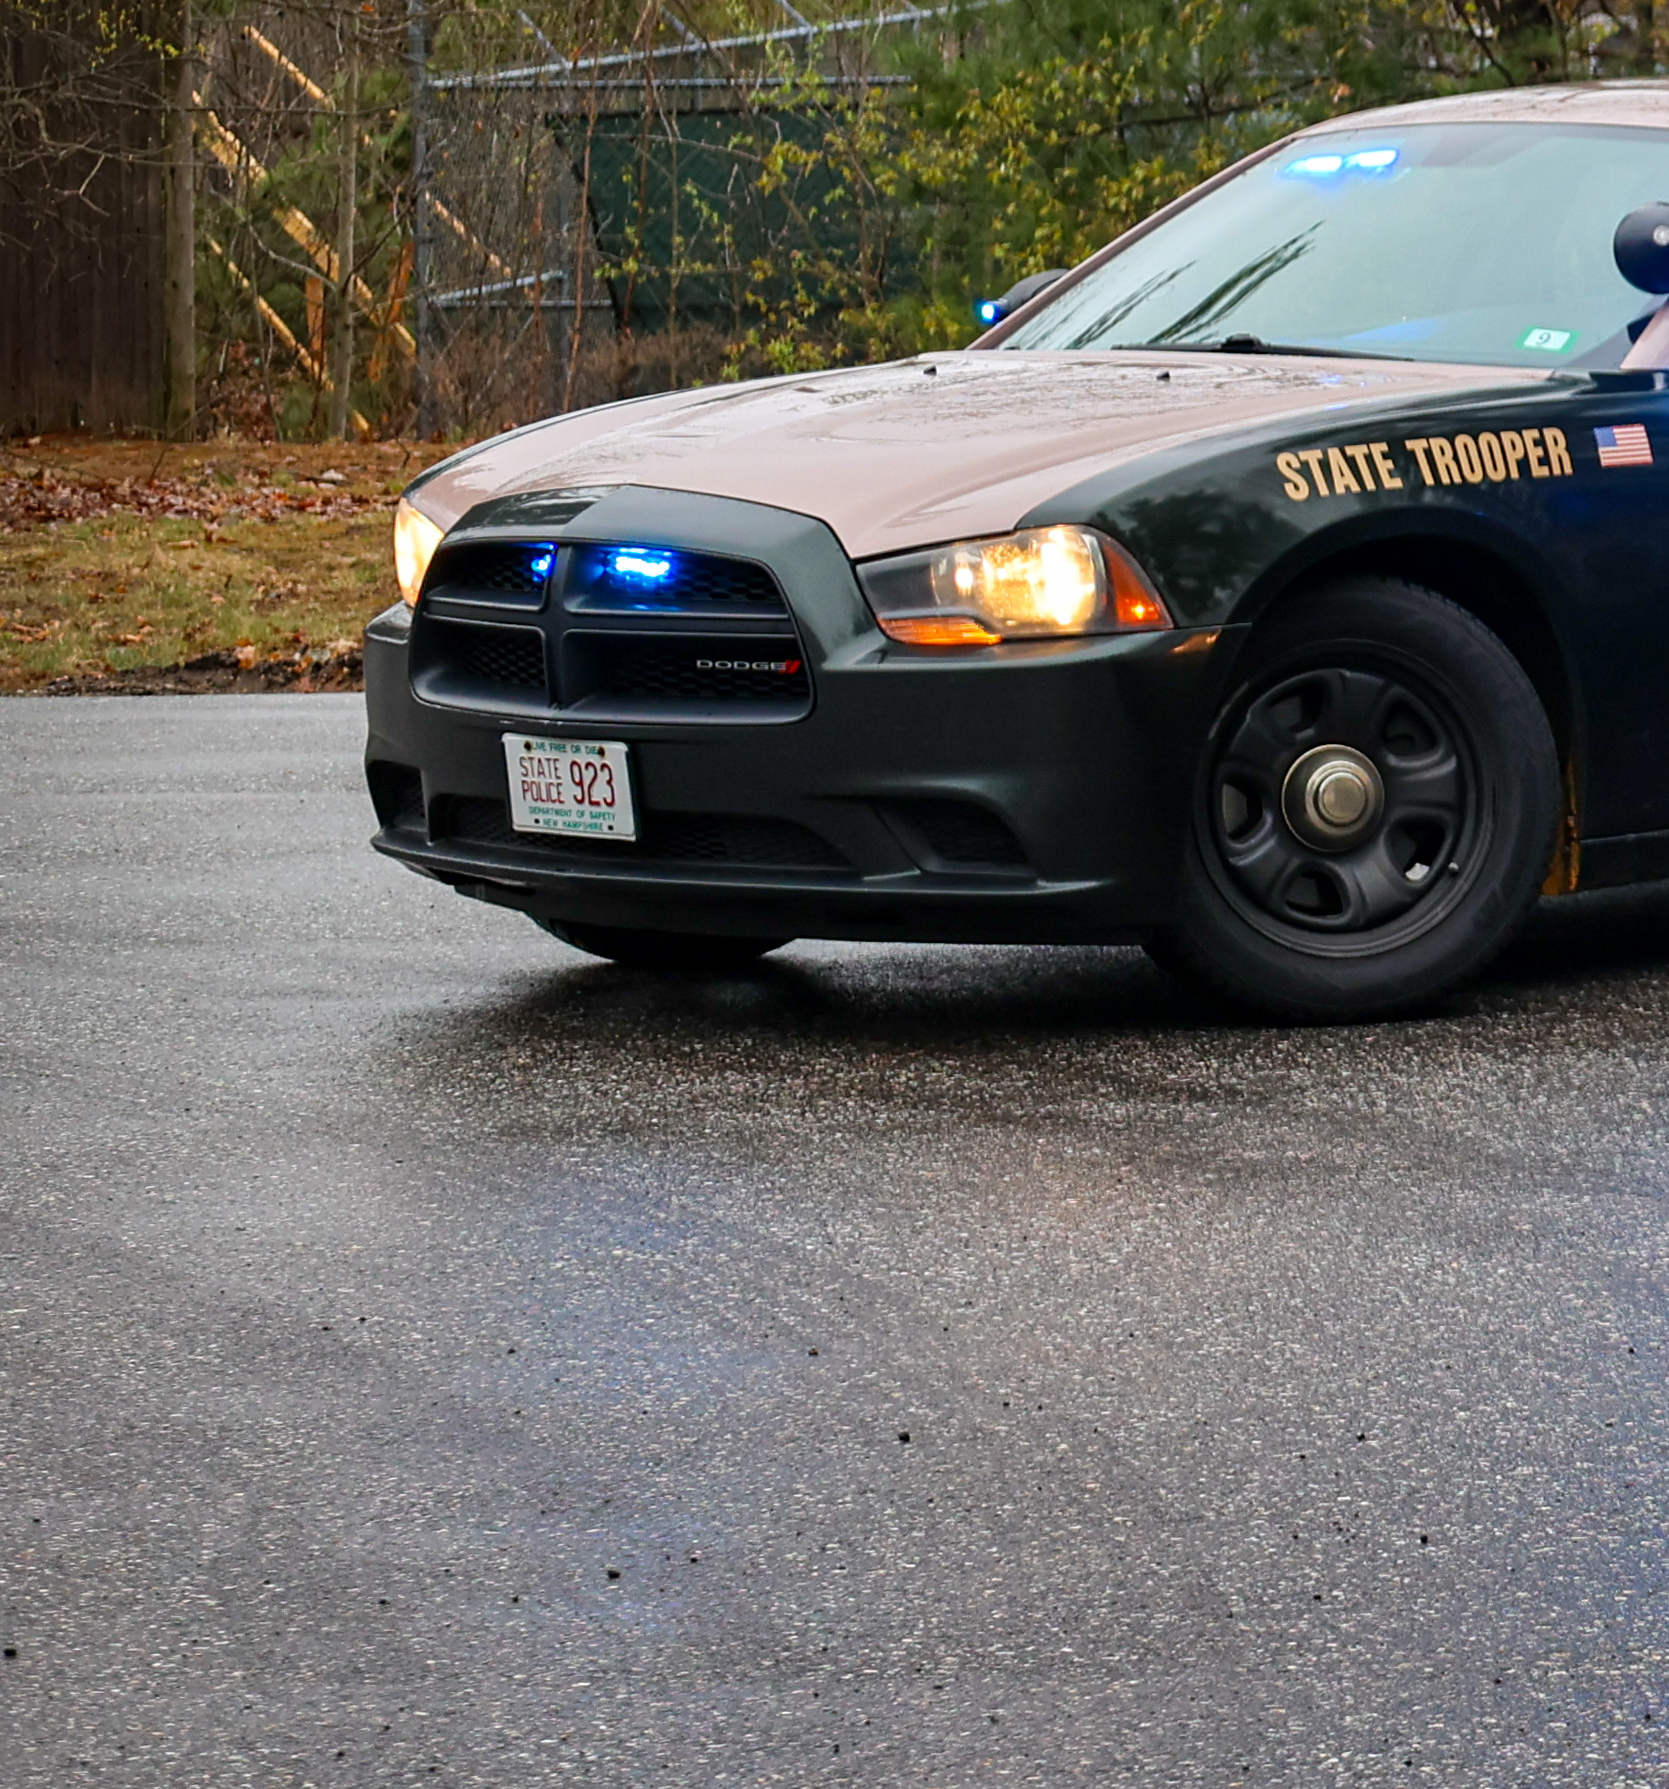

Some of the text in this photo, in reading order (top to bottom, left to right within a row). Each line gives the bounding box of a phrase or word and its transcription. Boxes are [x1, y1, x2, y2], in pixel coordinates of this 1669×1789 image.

[1276, 426, 1574, 502] STATE TROOPER
[696, 659, 788, 671] DODGE
[549, 742, 567, 753] FREE
[570, 744, 582, 754] OR
[518, 756, 616, 808] STATE 923
[521, 779, 566, 804] POLICE
[528, 805, 616, 822] DEPARTMENT OF SAFETY
[542, 818, 604, 831] NEW HAMPSHIRE
